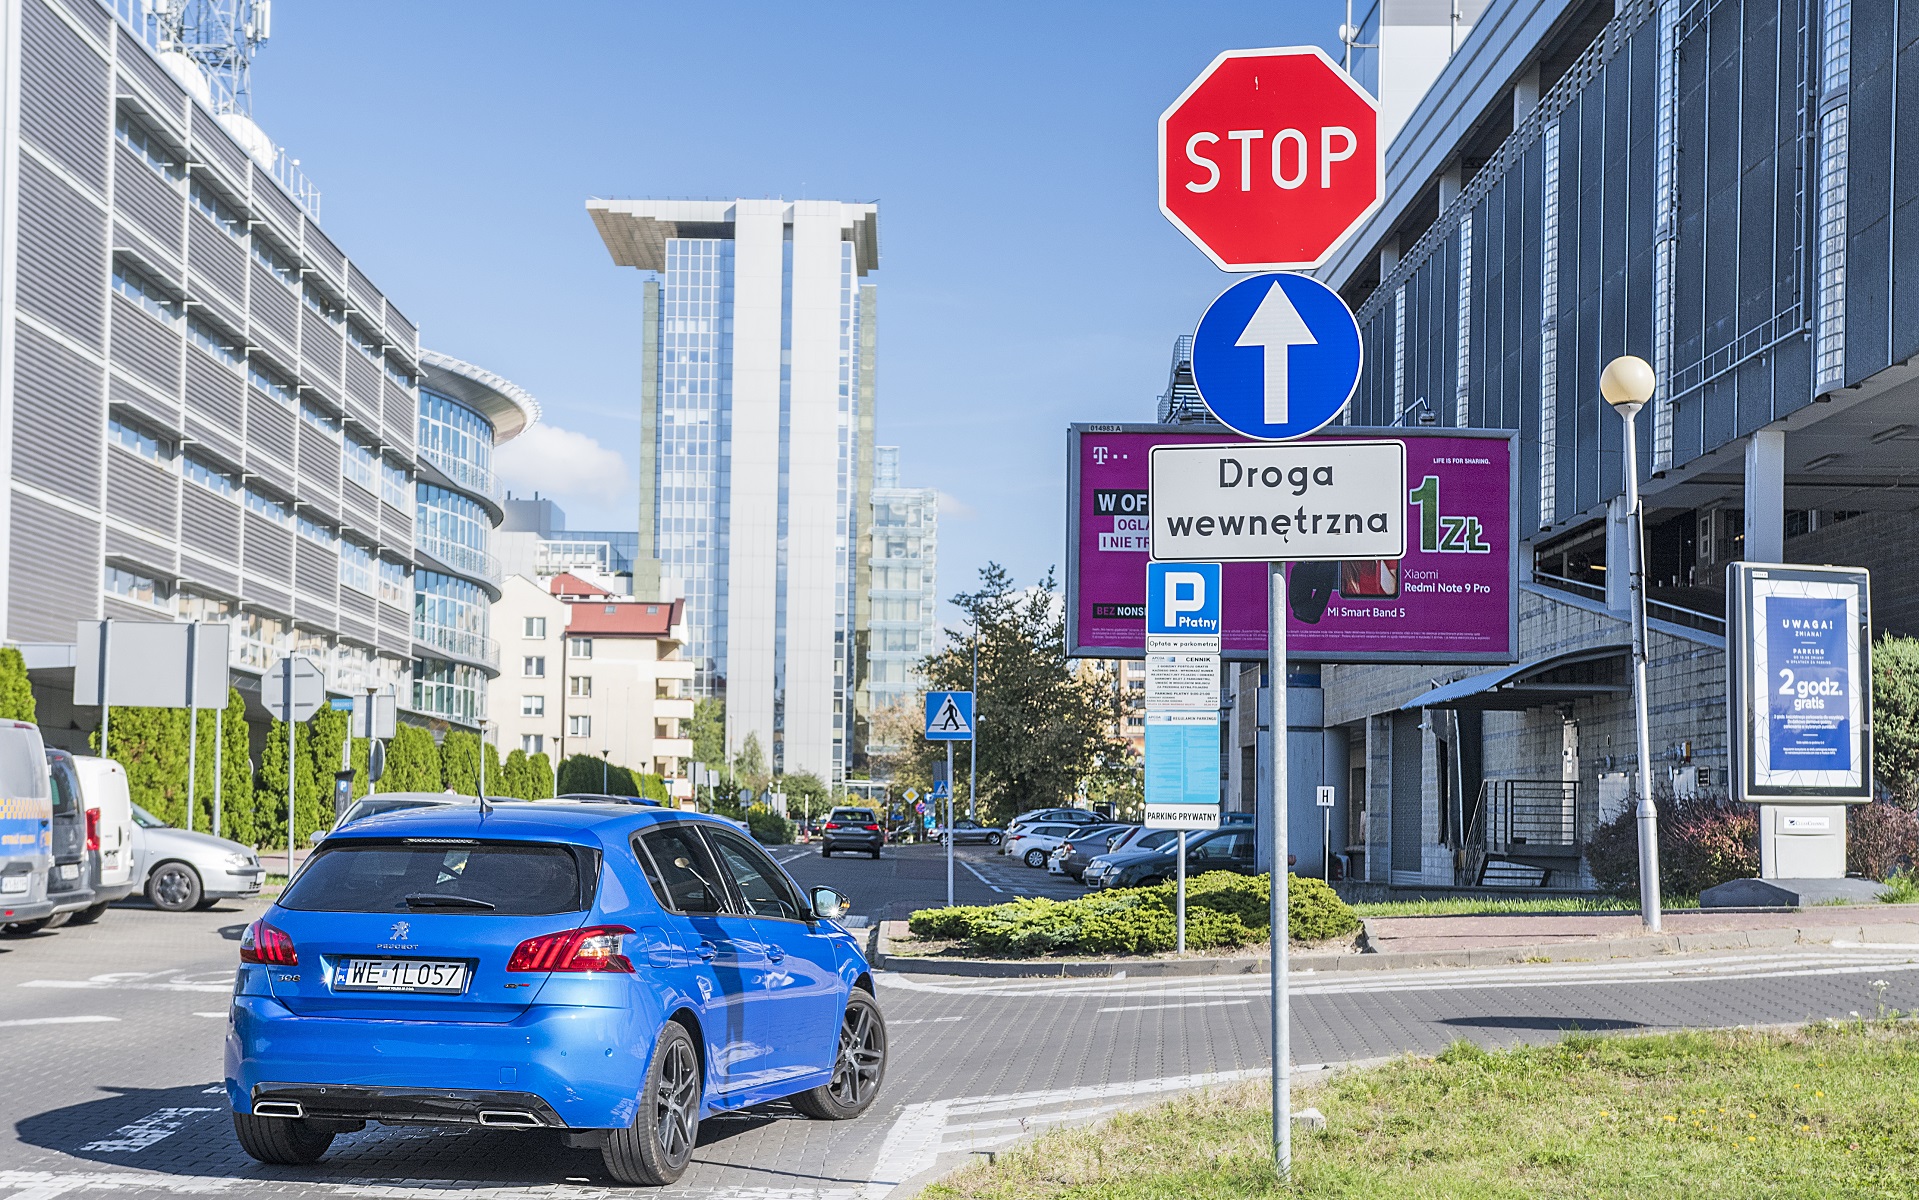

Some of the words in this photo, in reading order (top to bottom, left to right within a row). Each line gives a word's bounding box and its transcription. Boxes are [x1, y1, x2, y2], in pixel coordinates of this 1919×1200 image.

[1185, 126, 1357, 193] STOP
[1219, 458, 1333, 496] Droga
[1098, 494, 1117, 511] W
[1121, 493, 1149, 512] OF
[1166, 505, 1388, 544] wewnętrzna
[1103, 536, 1106, 548] I
[1110, 536, 1132, 548] NIE
[1404, 569, 1439, 580] Xiaomi
[1404, 582, 1436, 593] Redmi
[1438, 583, 1463, 593] Note
[1464, 583, 1471, 593] 9
[1473, 583, 1491, 593] Pro
[1164, 571, 1206, 627] P
[1096, 606, 1116, 616] BEZ
[1117, 606, 1146, 617] NONS
[1327, 607, 1339, 617] Mi
[1341, 607, 1371, 617] Smart
[1373, 607, 1397, 618] Band
[1399, 608, 1406, 618] 5
[1179, 616, 1217, 631] Płatny
[1782, 619, 1833, 630] UWAGA!
[1778, 668, 1795, 695] 2
[1797, 677, 1843, 698] godz.
[1794, 696, 1825, 711] gratis
[340, 781, 347, 791] P
[1322, 789, 1329, 803] H
[1147, 812, 1177, 820] PARKING
[1178, 812, 1217, 821] PRYWATNY
[278, 974, 301, 982] 308
[338, 974, 346, 982] PL
[352, 962, 382, 984] WE
[392, 963, 460, 986] 1L057
